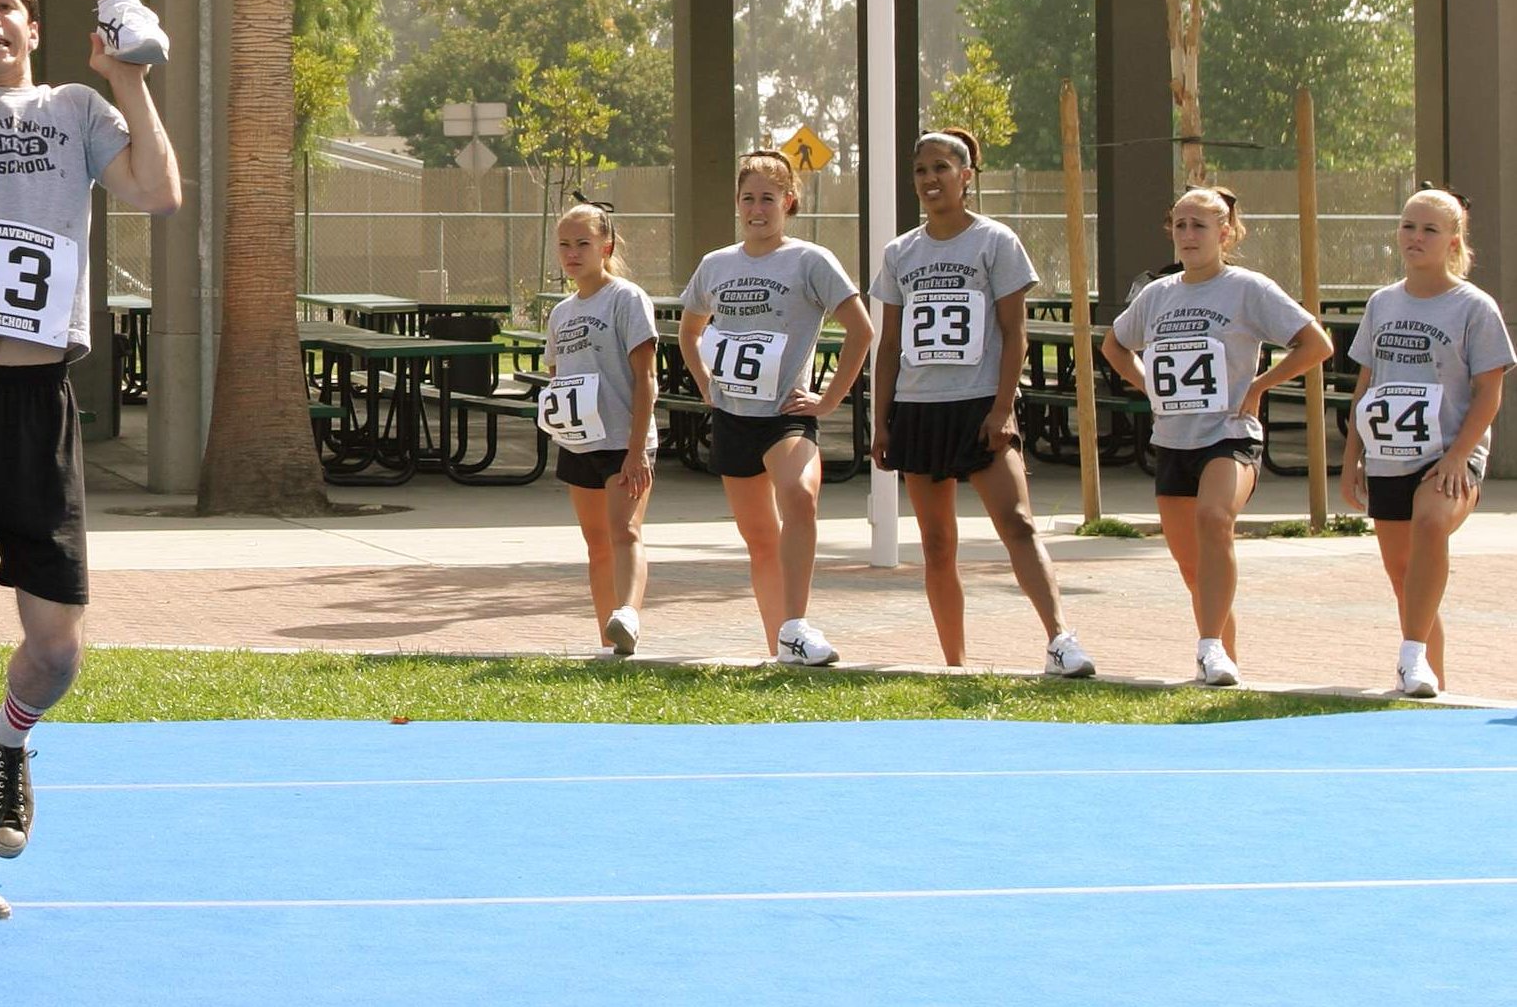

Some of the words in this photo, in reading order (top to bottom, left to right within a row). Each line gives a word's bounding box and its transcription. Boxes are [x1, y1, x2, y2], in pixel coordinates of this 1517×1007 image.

[737, 277, 790, 296] DAVENPORT
[900, 265, 927, 287] WEST
[739, 303, 772, 316] SCHOOL
[1173, 308, 1231, 326] DAVENPORT
[913, 305, 970, 347] 23
[1395, 320, 1452, 346] DAVENPORT
[1380, 335, 1426, 349] DONKEYS
[711, 338, 765, 381] 16
[1396, 352, 1433, 364] SCHOOL
[1153, 353, 1217, 397] 64
[544, 388, 583, 428] 21
[1366, 399, 1430, 442] 24
